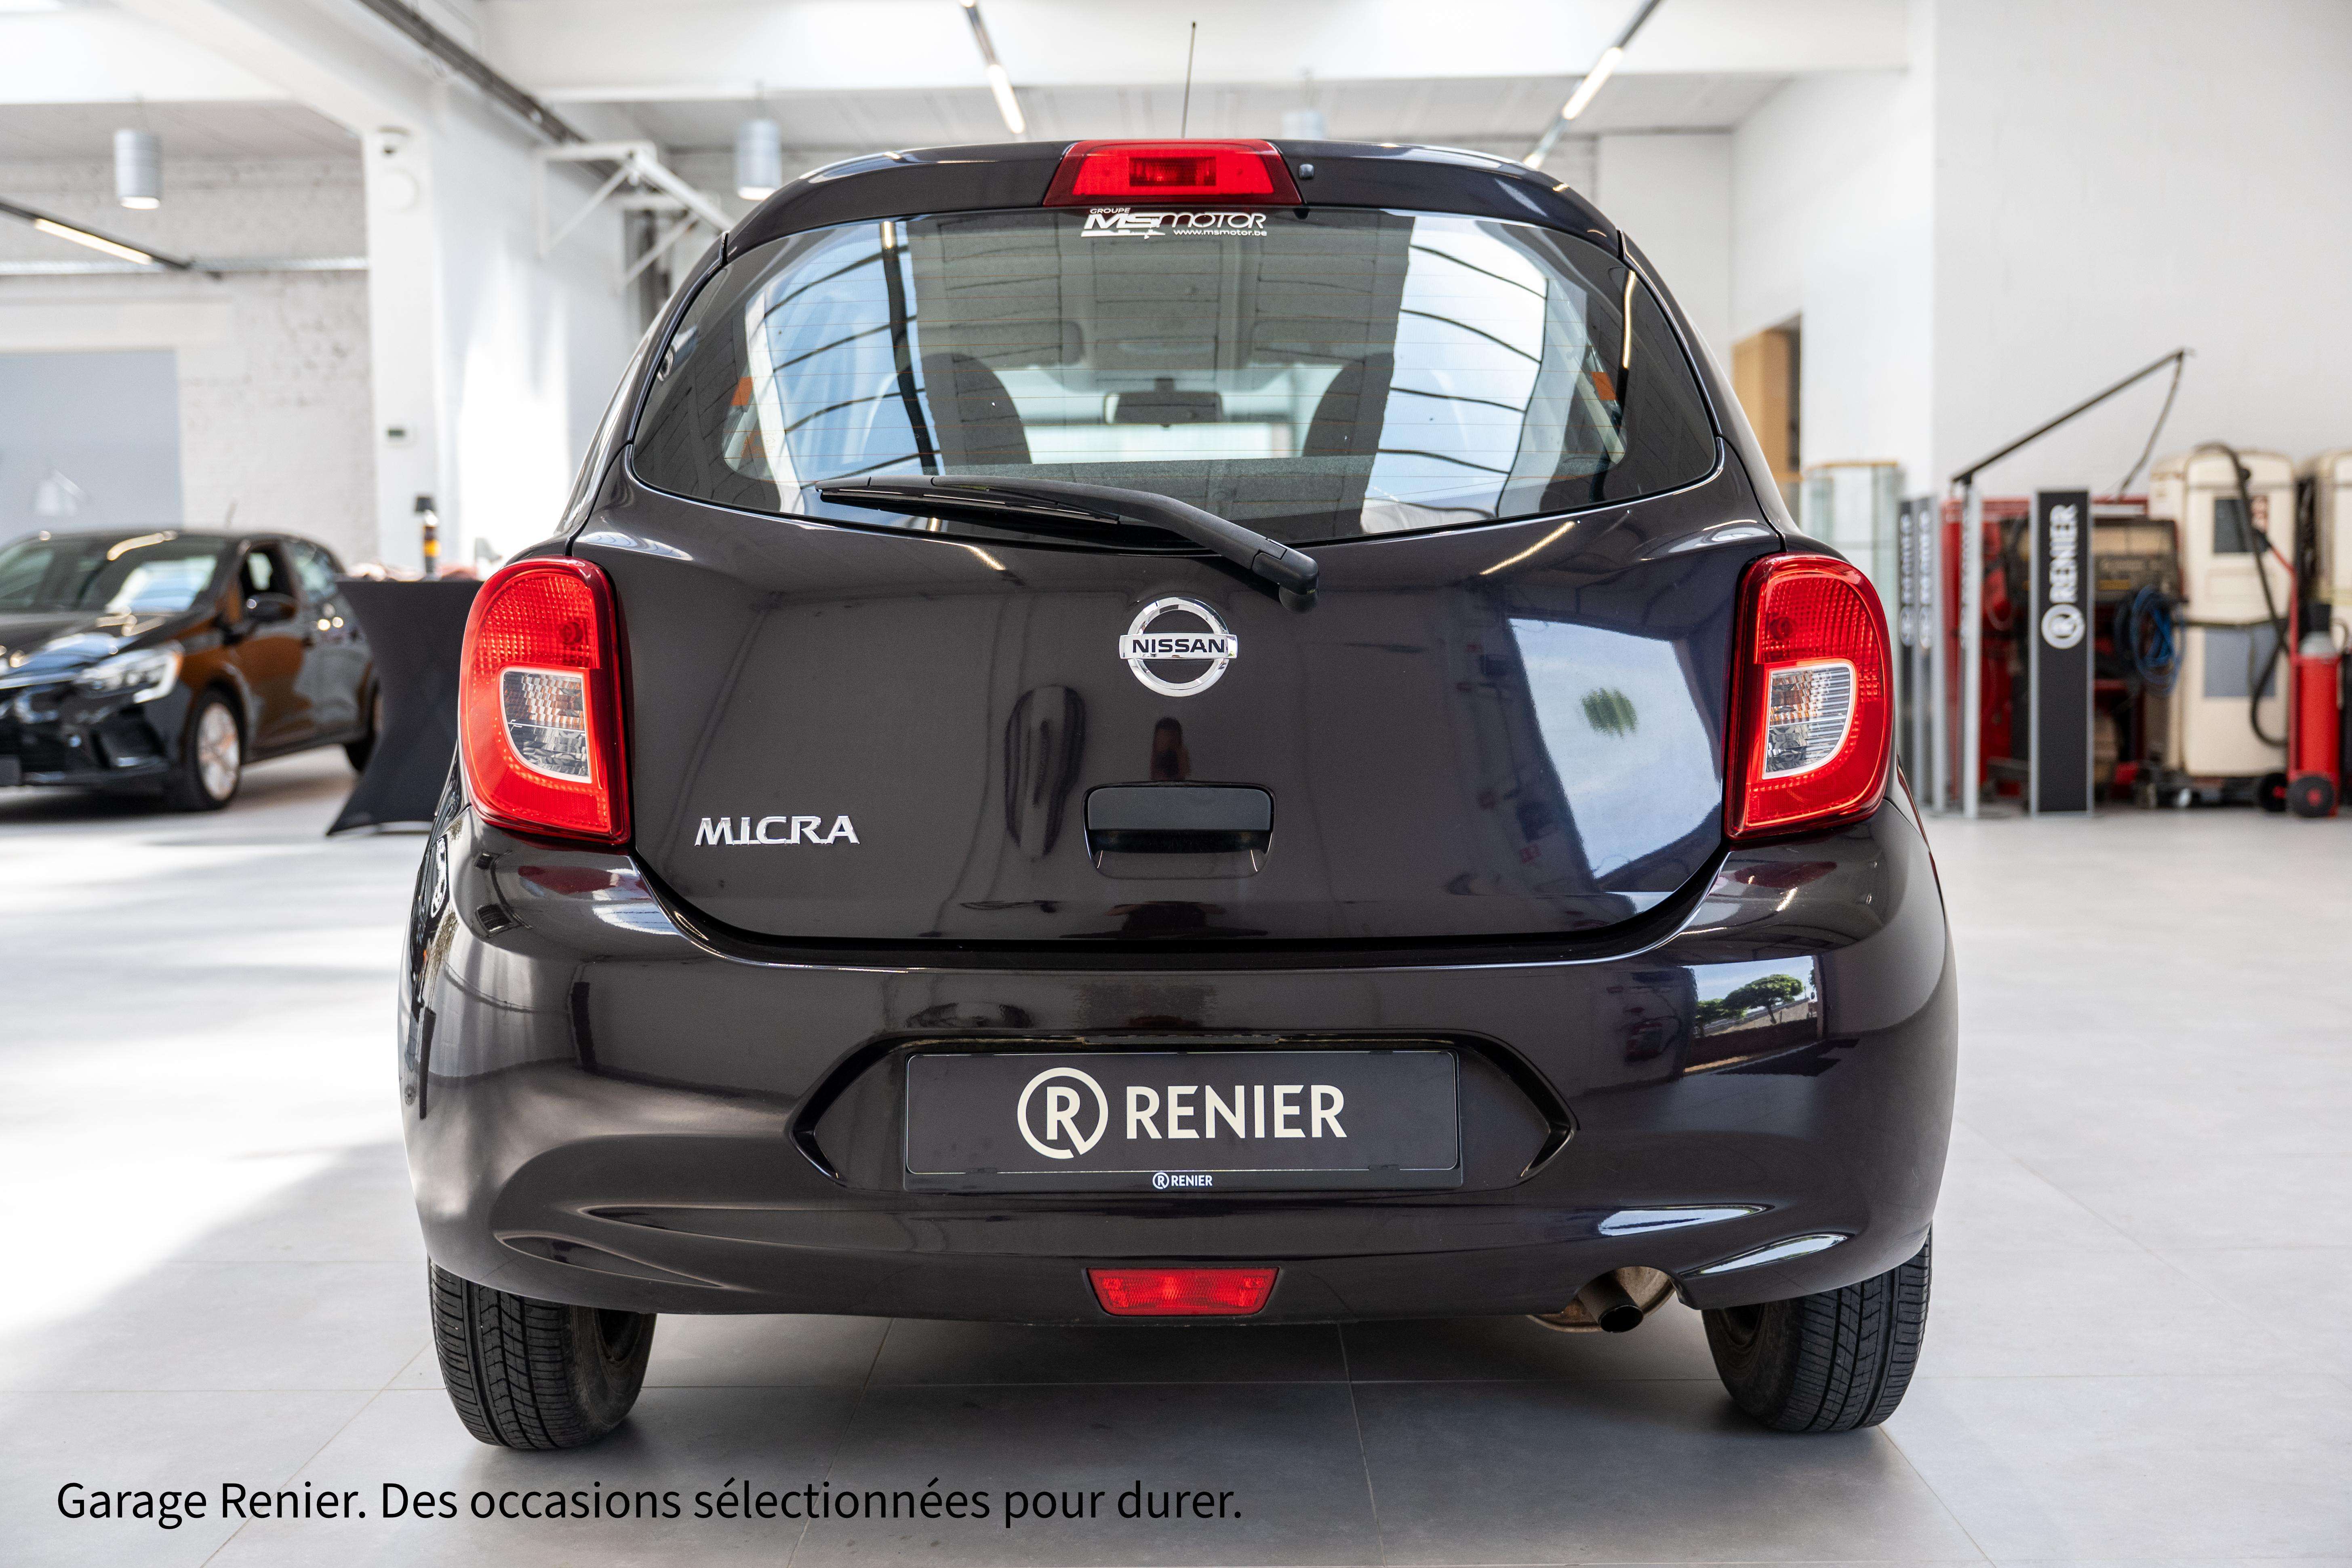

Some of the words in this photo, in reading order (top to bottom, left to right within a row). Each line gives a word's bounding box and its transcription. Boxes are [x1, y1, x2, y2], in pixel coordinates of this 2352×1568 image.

[1173, 229, 1268, 237] www.msmotor.be
[2049, 504, 2078, 604] RENIER
[1133, 639, 1225, 653] NISSAN
[694, 815, 860, 846] MICRA
[1127, 1084, 1348, 1139] RENIER
[1171, 1175, 1213, 1186] RENIER
